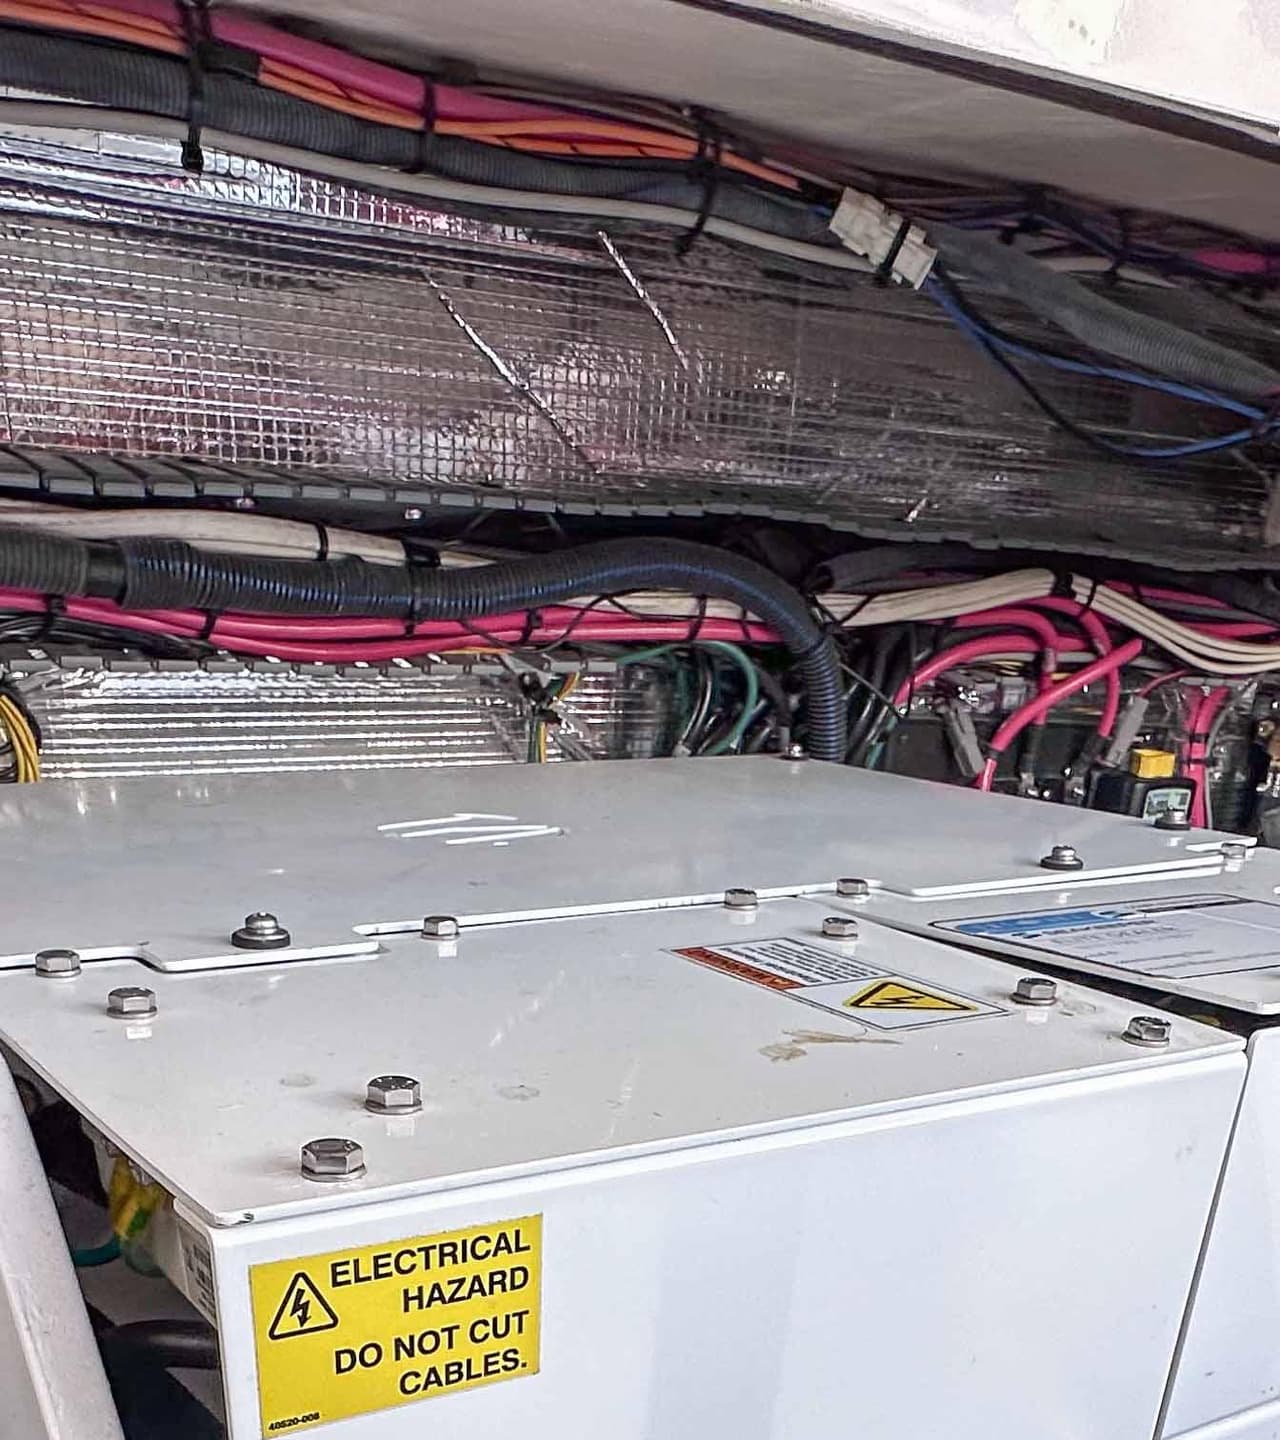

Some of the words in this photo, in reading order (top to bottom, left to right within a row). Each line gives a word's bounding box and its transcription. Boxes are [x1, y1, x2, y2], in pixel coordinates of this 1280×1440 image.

[331, 1229, 531, 1288] ELECTRICAL
[403, 1266, 529, 1312] HAZARD
[335, 1343, 383, 1374] DO
[394, 1325, 460, 1361] NOT
[469, 1310, 530, 1344] CUT
[399, 1349, 527, 1395] CABLES.
